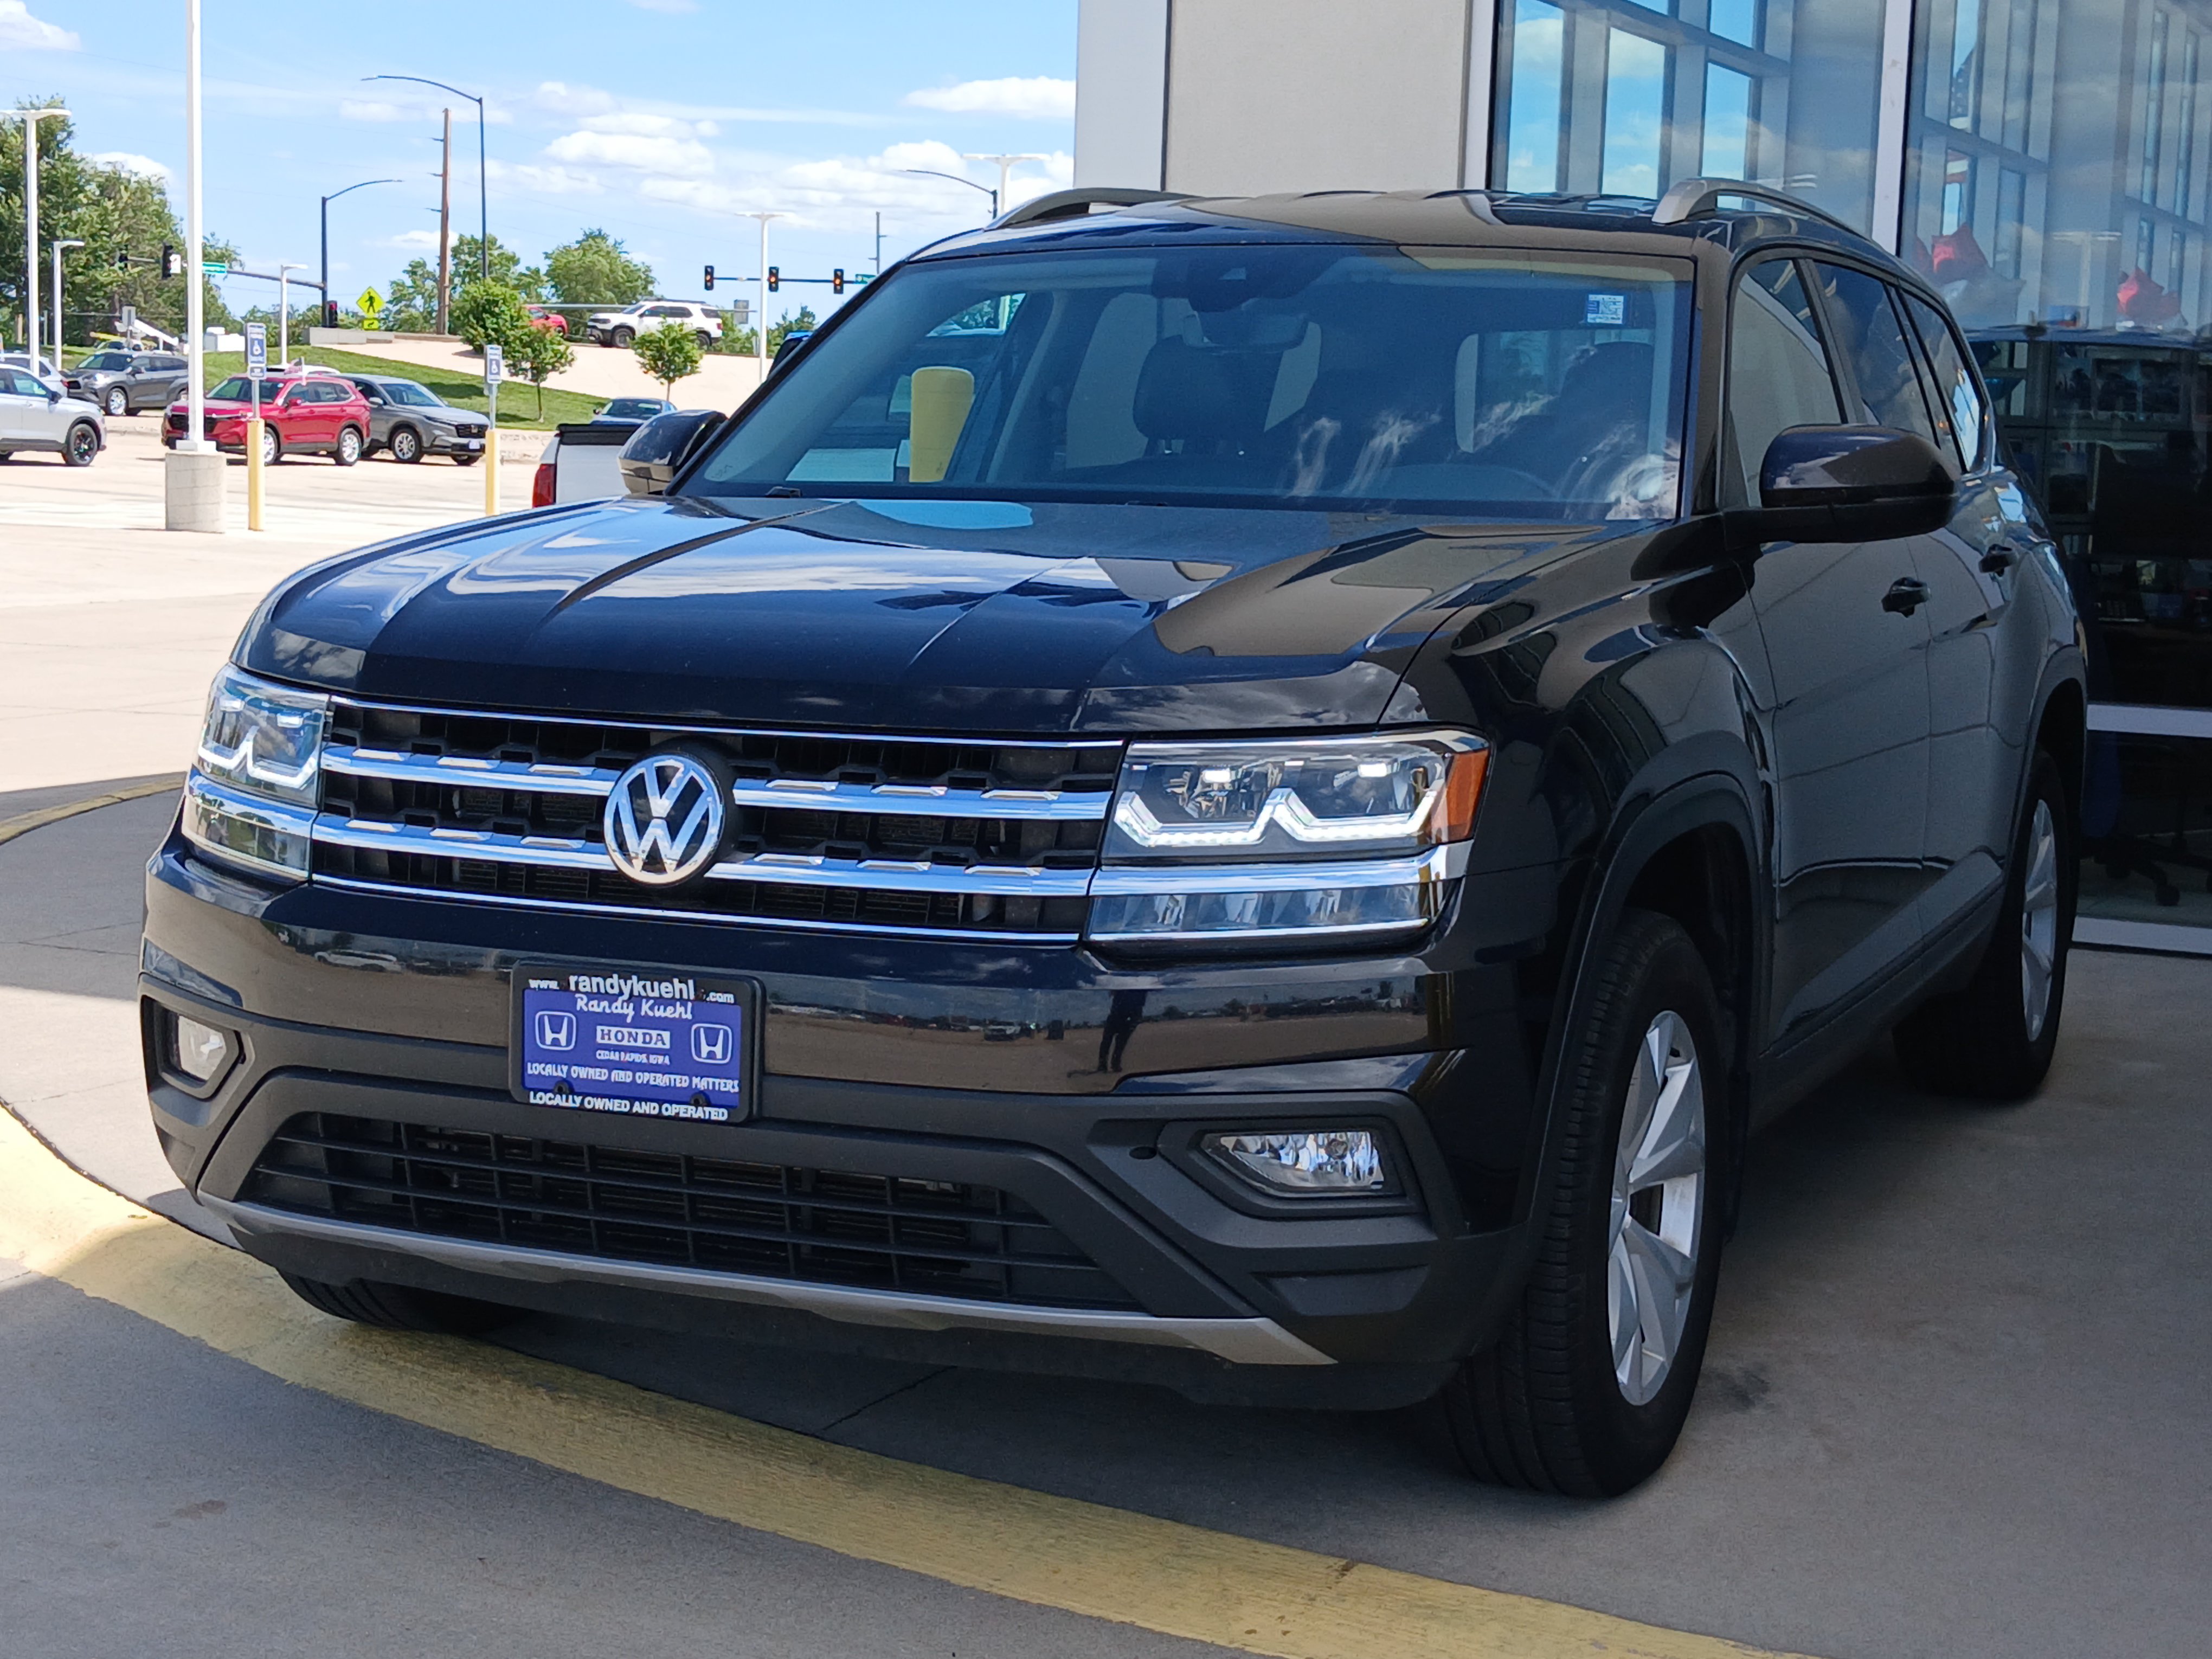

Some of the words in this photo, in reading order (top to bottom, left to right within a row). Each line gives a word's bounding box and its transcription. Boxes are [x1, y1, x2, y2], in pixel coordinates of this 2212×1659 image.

[569, 974, 695, 1000] randykuehl
[575, 993, 635, 1023] Randy
[641, 999, 692, 1020] Kuehl
[600, 1028, 667, 1046] HONDA
[527, 1062, 569, 1078] LOCALLY
[571, 1066, 609, 1081] OWNED
[611, 1070, 633, 1083] AND
[635, 1072, 690, 1088] OPERATED
[692, 1076, 740, 1093] MATTERS
[529, 1090, 583, 1108] LOCALLY
[584, 1096, 631, 1113] OWNED
[633, 1101, 660, 1115] AND
[661, 1103, 728, 1121] OPERATED
